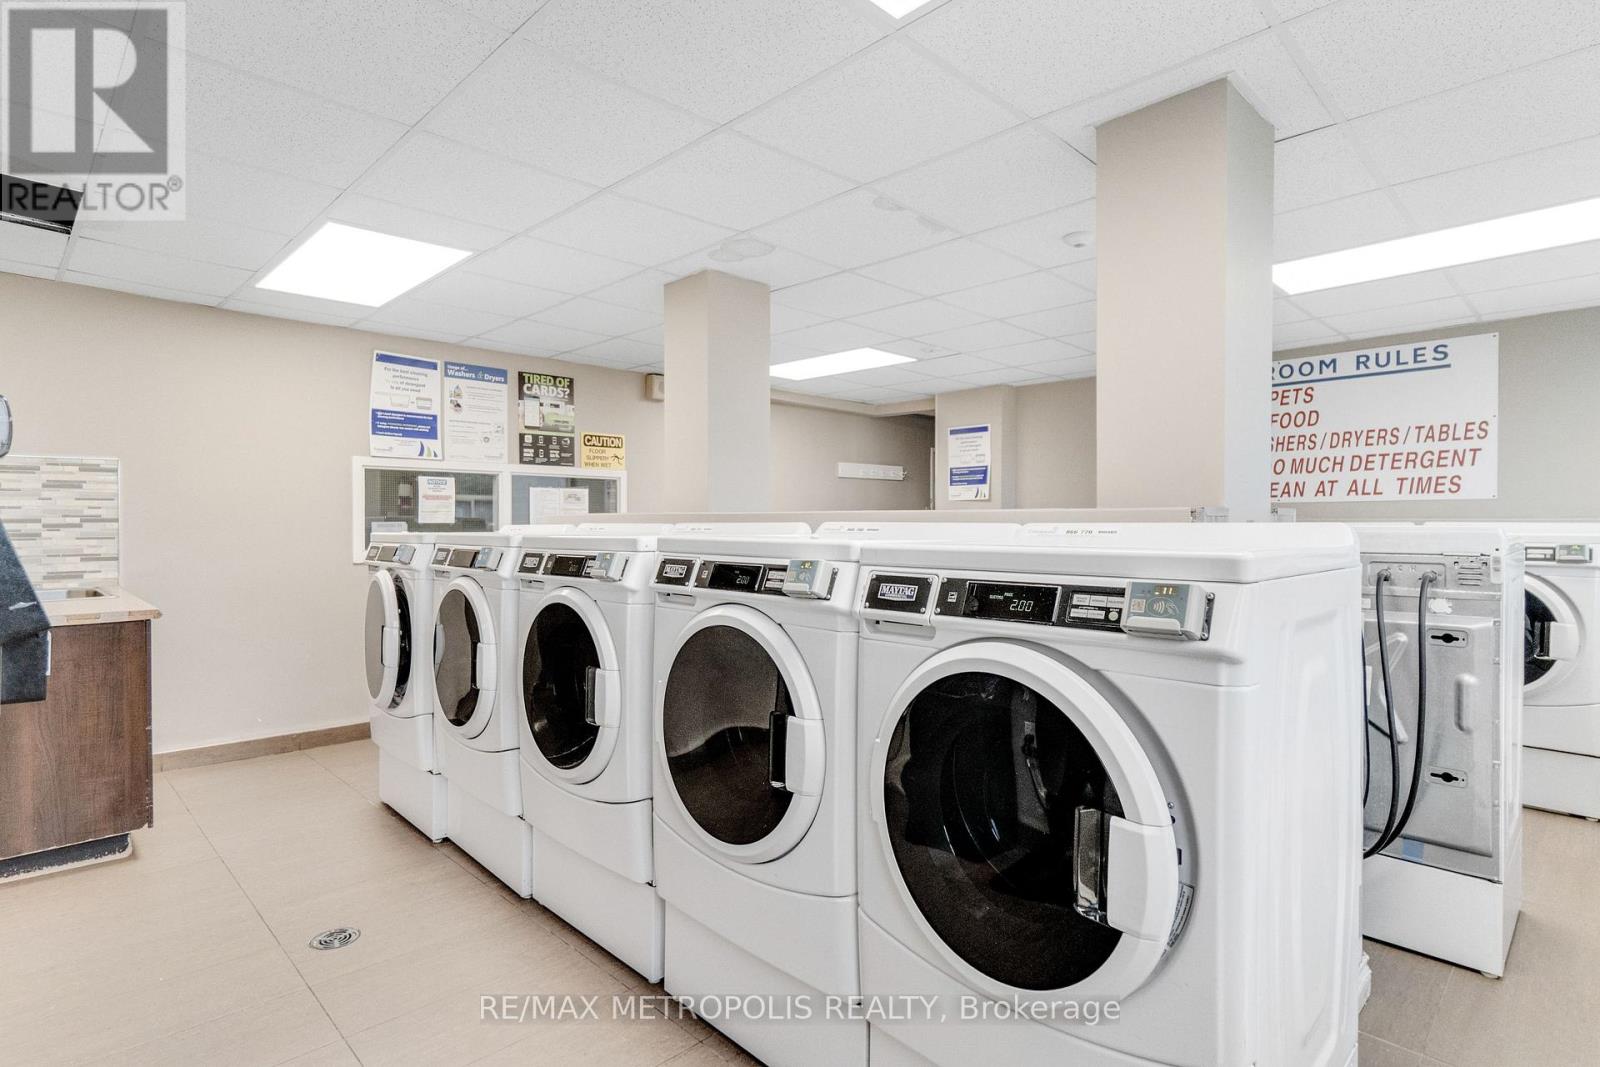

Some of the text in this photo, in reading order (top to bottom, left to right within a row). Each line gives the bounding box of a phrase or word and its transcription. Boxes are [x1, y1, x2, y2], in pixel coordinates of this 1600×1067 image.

[1272, 344, 1449, 380] OOM RULES
[447, 369, 476, 378] Washers
[484, 374, 505, 382] Dryers
[523, 373, 570, 388] TIRED OF
[523, 383, 570, 399] CARDS?
[1272, 386, 1314, 406] PETS
[1272, 410, 1320, 429] FOOD
[584, 435, 622, 448] CAUTION
[1290, 455, 1345, 475] MUCH
[1349, 448, 1482, 473] DETERGENT
[1270, 474, 1462, 498] EAN AT ALL TIMES
[881, 585, 915, 595] MAYTAG
[1010, 599, 1034, 611] 2.00
